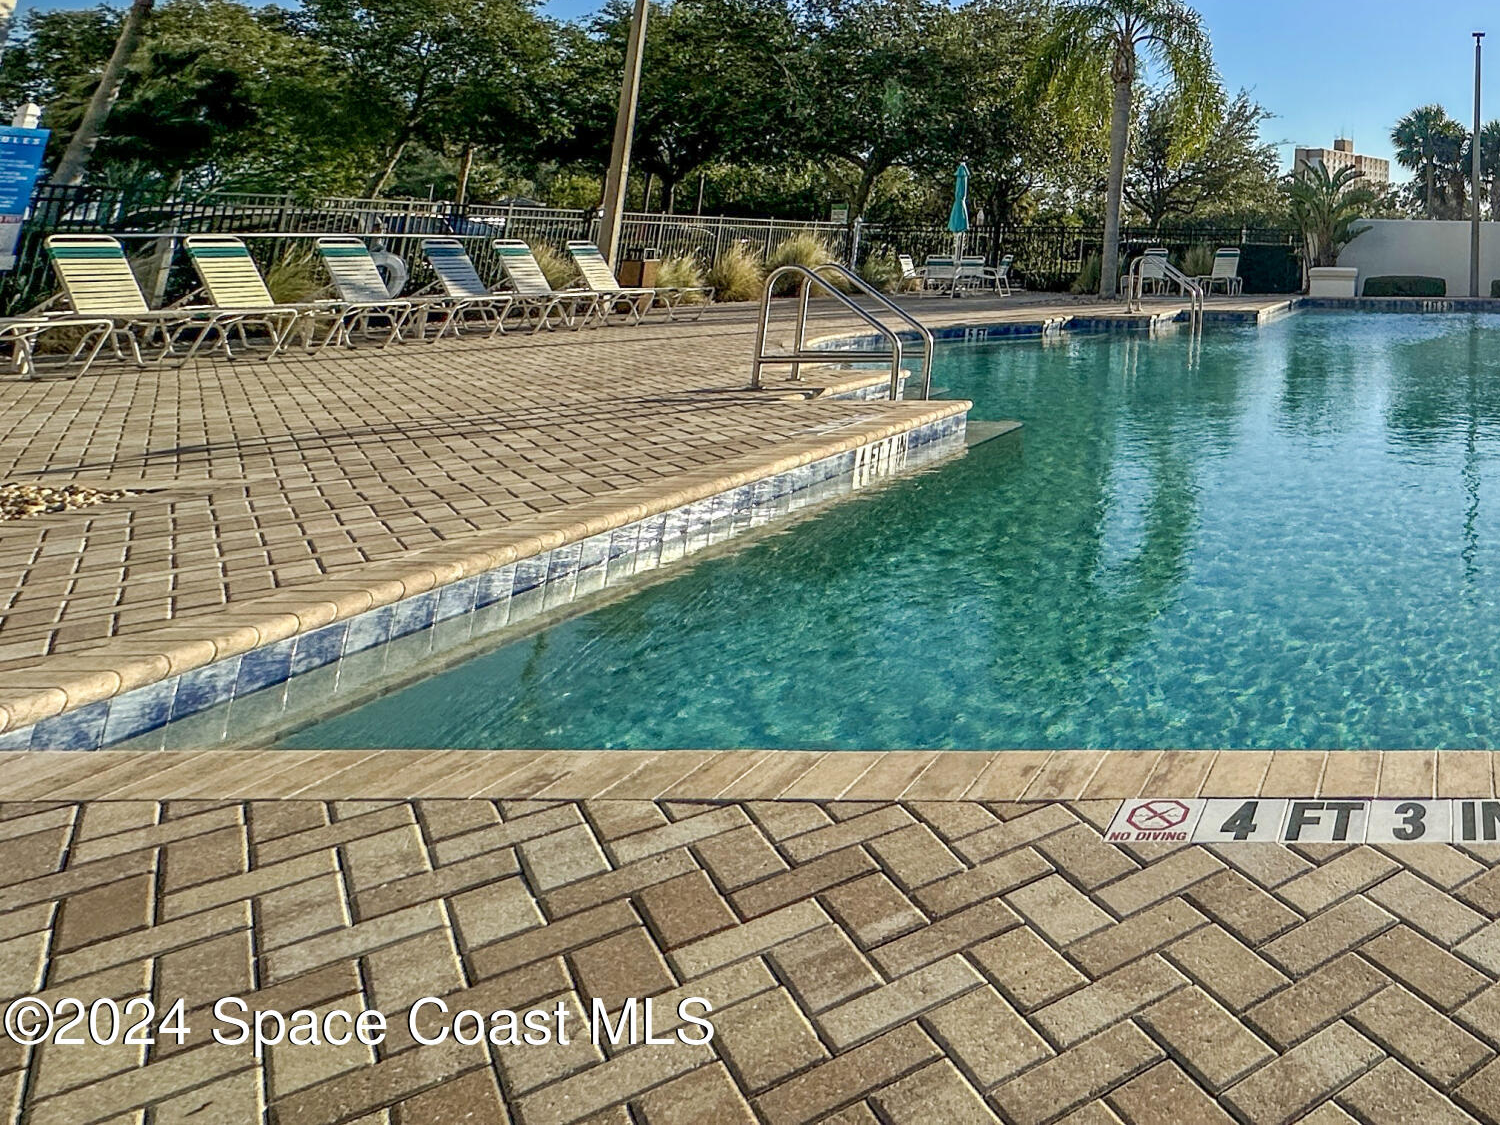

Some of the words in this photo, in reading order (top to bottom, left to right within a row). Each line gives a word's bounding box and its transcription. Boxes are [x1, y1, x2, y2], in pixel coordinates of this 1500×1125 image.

[1220, 801, 1259, 840] 4
[1284, 802, 1364, 841] FT
[1392, 802, 1426, 840] 3
[1109, 832, 1131, 841] NO
[1134, 832, 1187, 841] DIVING
